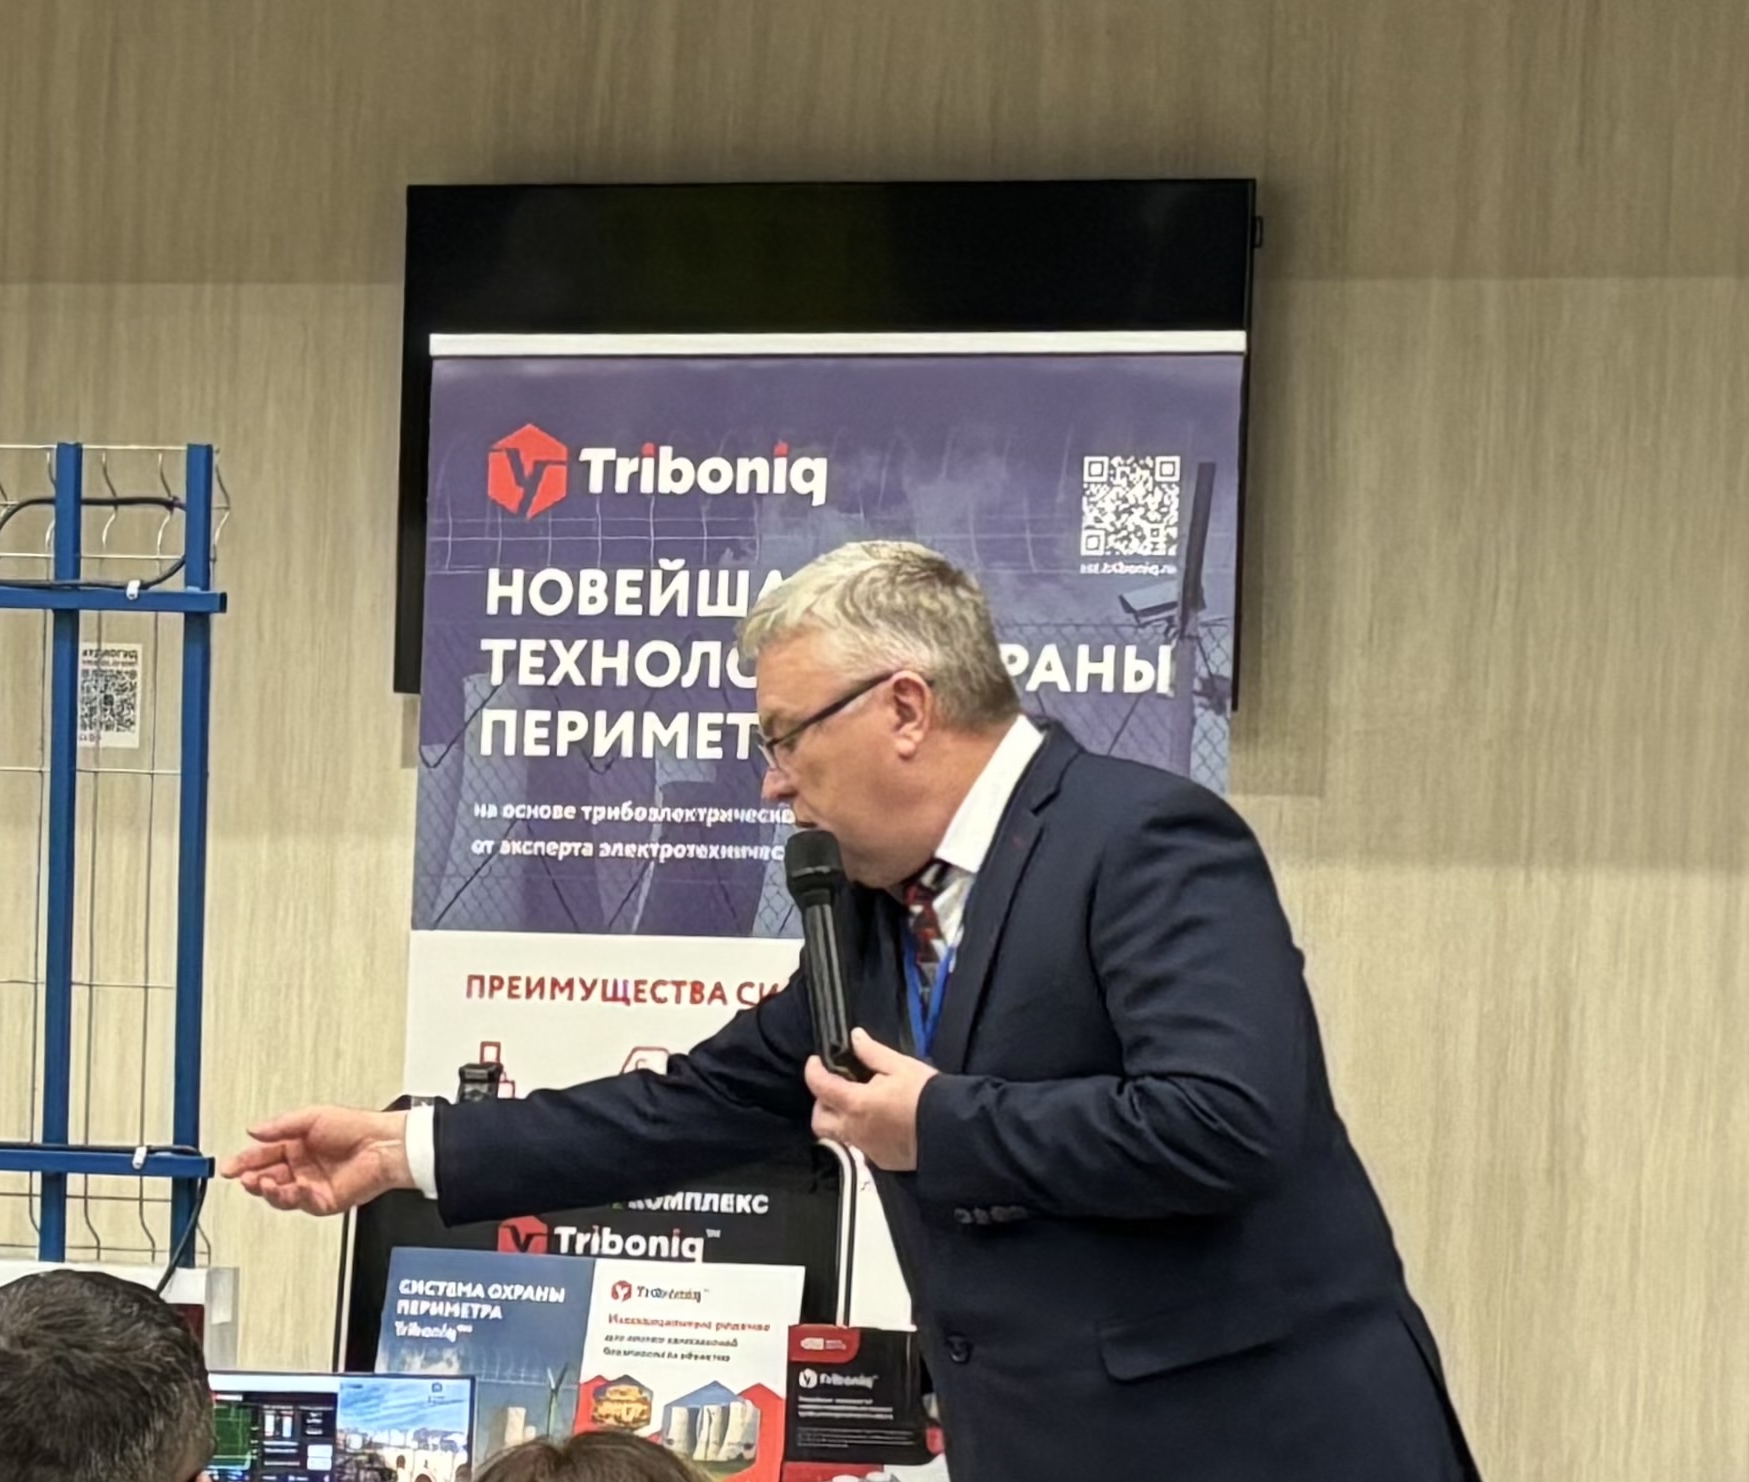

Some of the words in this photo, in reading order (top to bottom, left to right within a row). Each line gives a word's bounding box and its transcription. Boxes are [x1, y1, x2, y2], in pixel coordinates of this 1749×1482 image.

[579, 441, 828, 507] Triboniq
[473, 802, 498, 819] на
[502, 803, 576, 820] основе
[470, 839, 494, 855] от
[499, 841, 594, 860] эксперта
[466, 974, 728, 1006] ПРЕИМУЩЕСТВА
[398, 1279, 485, 1299] СИСТЕМА
[487, 1283, 566, 1303] ОХРАНЫ
[396, 1299, 503, 1320] ПЕРИМЕТРА
